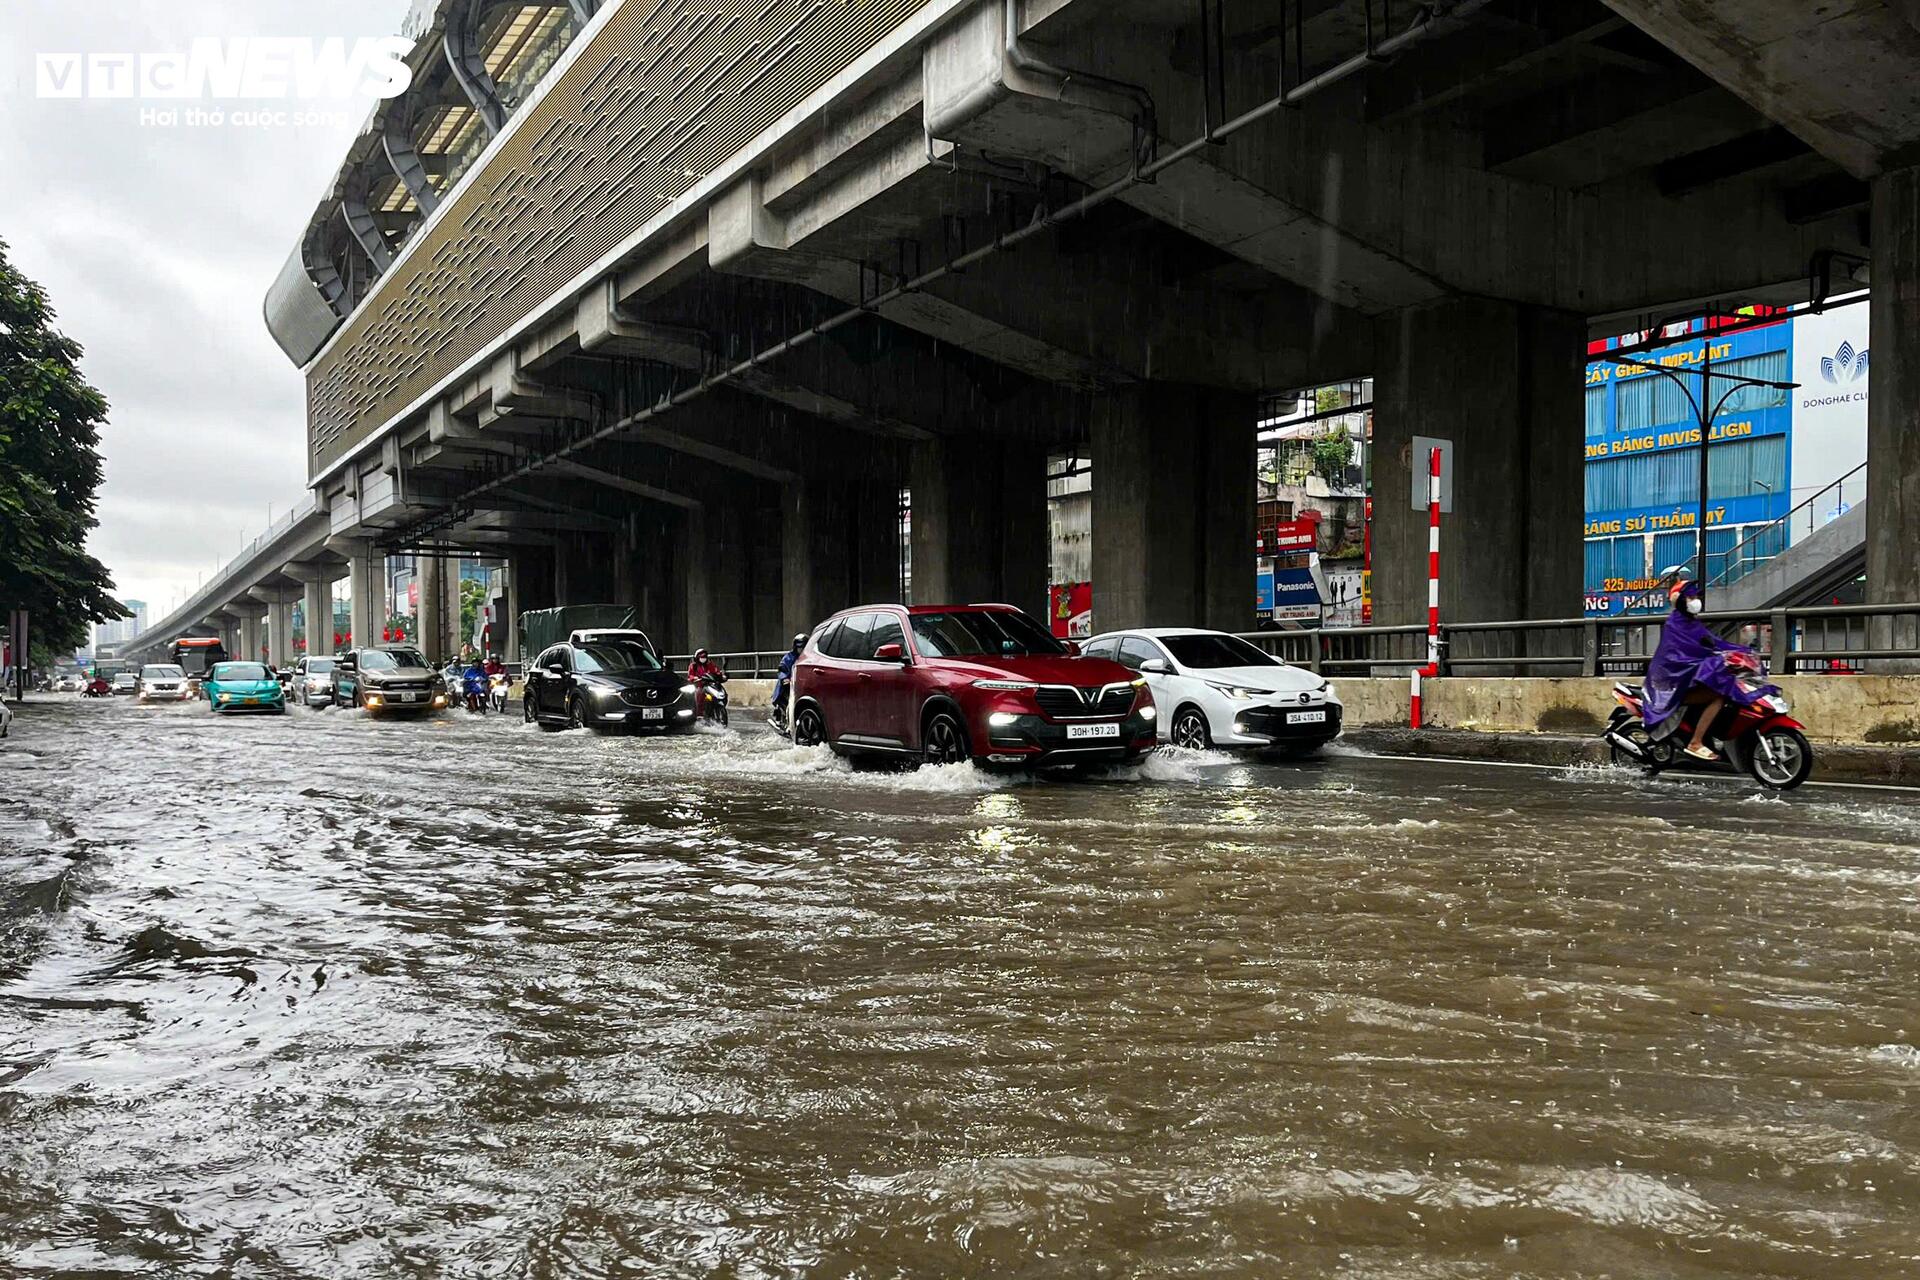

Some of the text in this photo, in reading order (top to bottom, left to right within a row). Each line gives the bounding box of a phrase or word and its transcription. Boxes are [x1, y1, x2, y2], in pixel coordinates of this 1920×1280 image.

[1803, 394, 1851, 408] DONGHAE
[1612, 436, 1655, 454] RĂNG
[1625, 514, 1647, 531] SỨ
[1649, 506, 1696, 529] THẨM
[1277, 581, 1315, 592] Panasonic
[1604, 578, 1624, 592] 325
